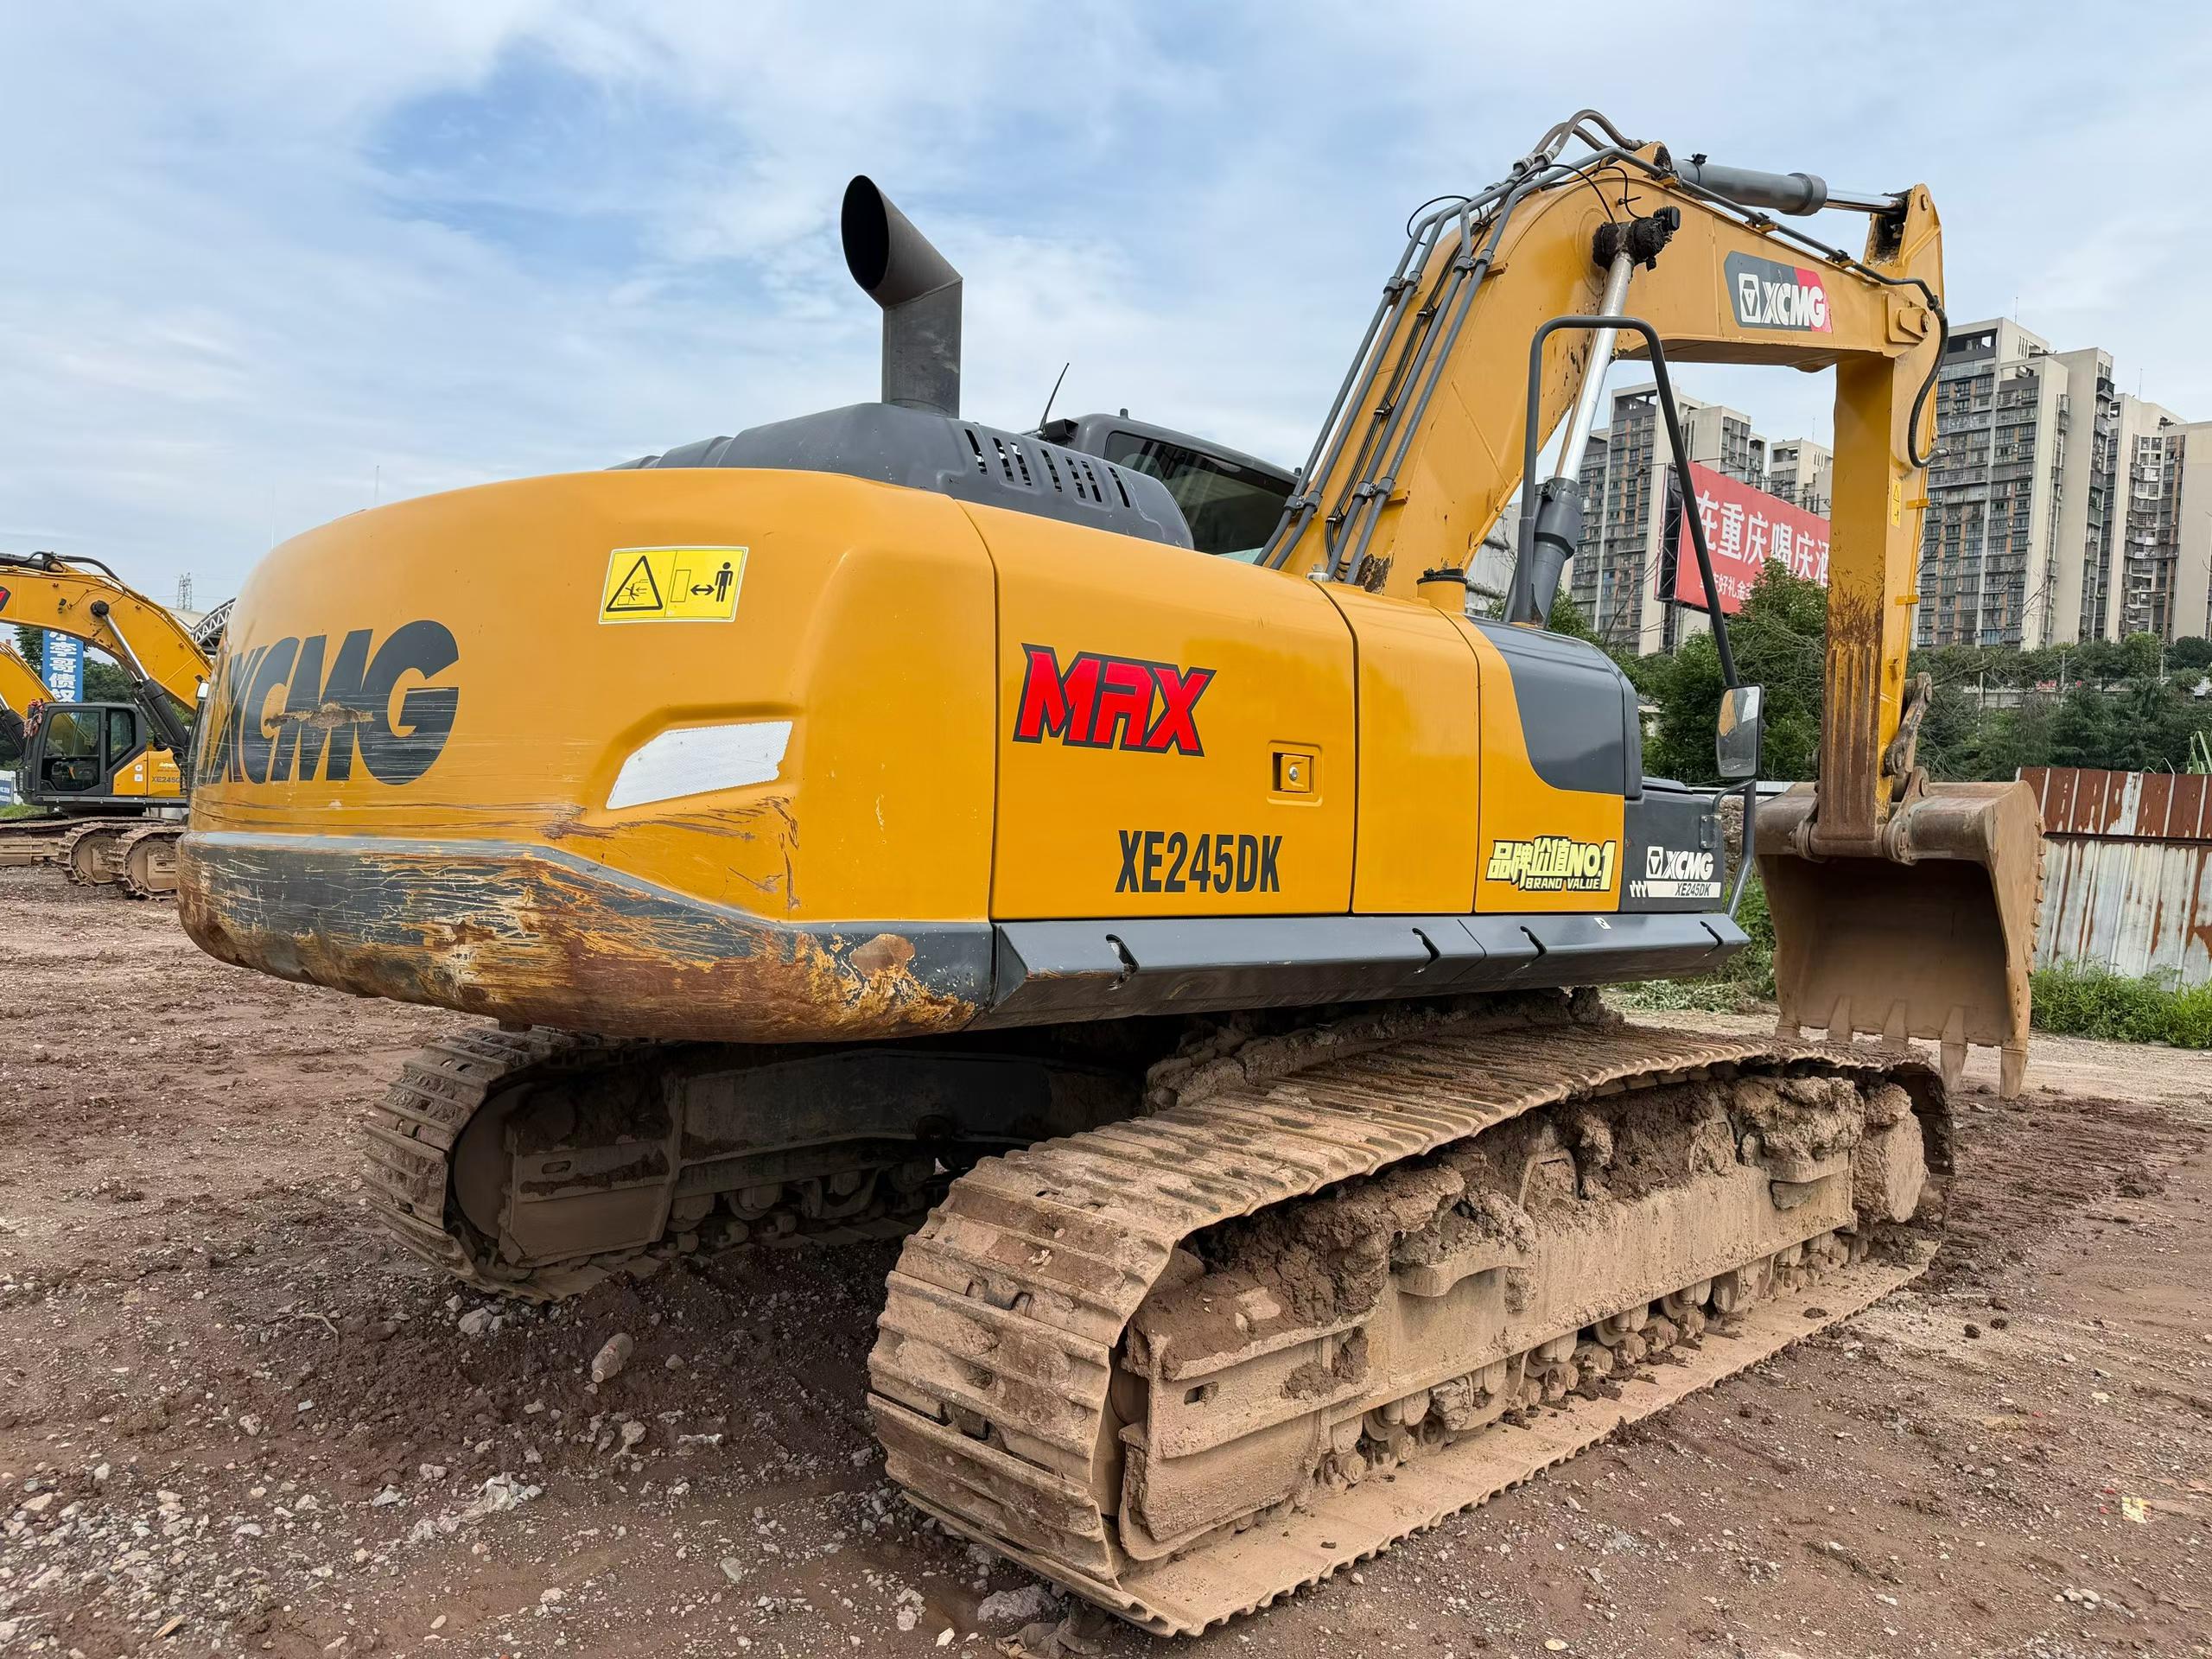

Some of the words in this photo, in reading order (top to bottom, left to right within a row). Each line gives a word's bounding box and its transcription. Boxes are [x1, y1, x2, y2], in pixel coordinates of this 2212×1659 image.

[1761, 281, 1825, 327] XCMG
[204, 620, 460, 785] XCMG
[1014, 643, 1216, 757] MAX
[1115, 830, 1282, 893] XE245DK
[1526, 878, 1562, 890] BRAND
[1567, 879, 1600, 890] VALUE
[1662, 851, 1713, 880] XCMG
[1675, 882, 1711, 896] XE245DK
